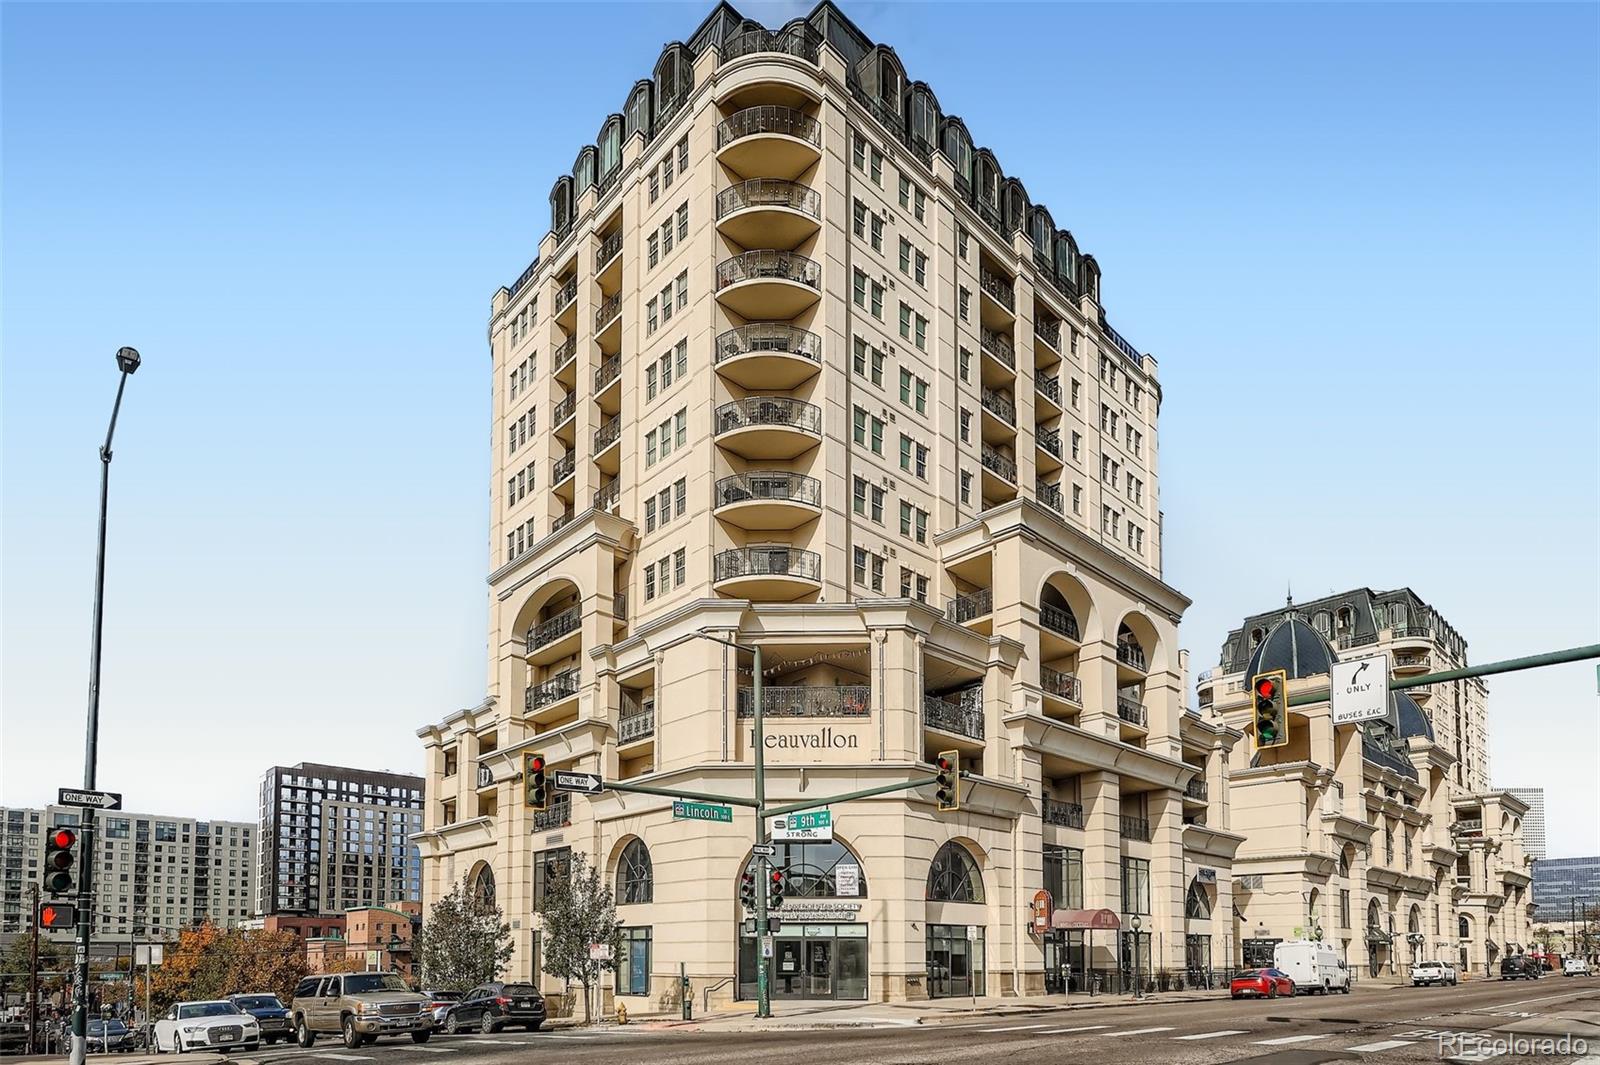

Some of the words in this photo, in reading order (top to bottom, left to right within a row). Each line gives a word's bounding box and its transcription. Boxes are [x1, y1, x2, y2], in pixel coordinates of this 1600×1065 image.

[1346, 683, 1371, 695] ONLY
[1338, 710, 1363, 720] BUSES
[559, 776, 573, 785] ONE
[575, 778, 588, 786] WAY
[64, 793, 83, 802] ONE
[85, 795, 103, 804] WAY
[686, 804, 719, 819] Lincoln
[801, 815, 815, 827] 9th
